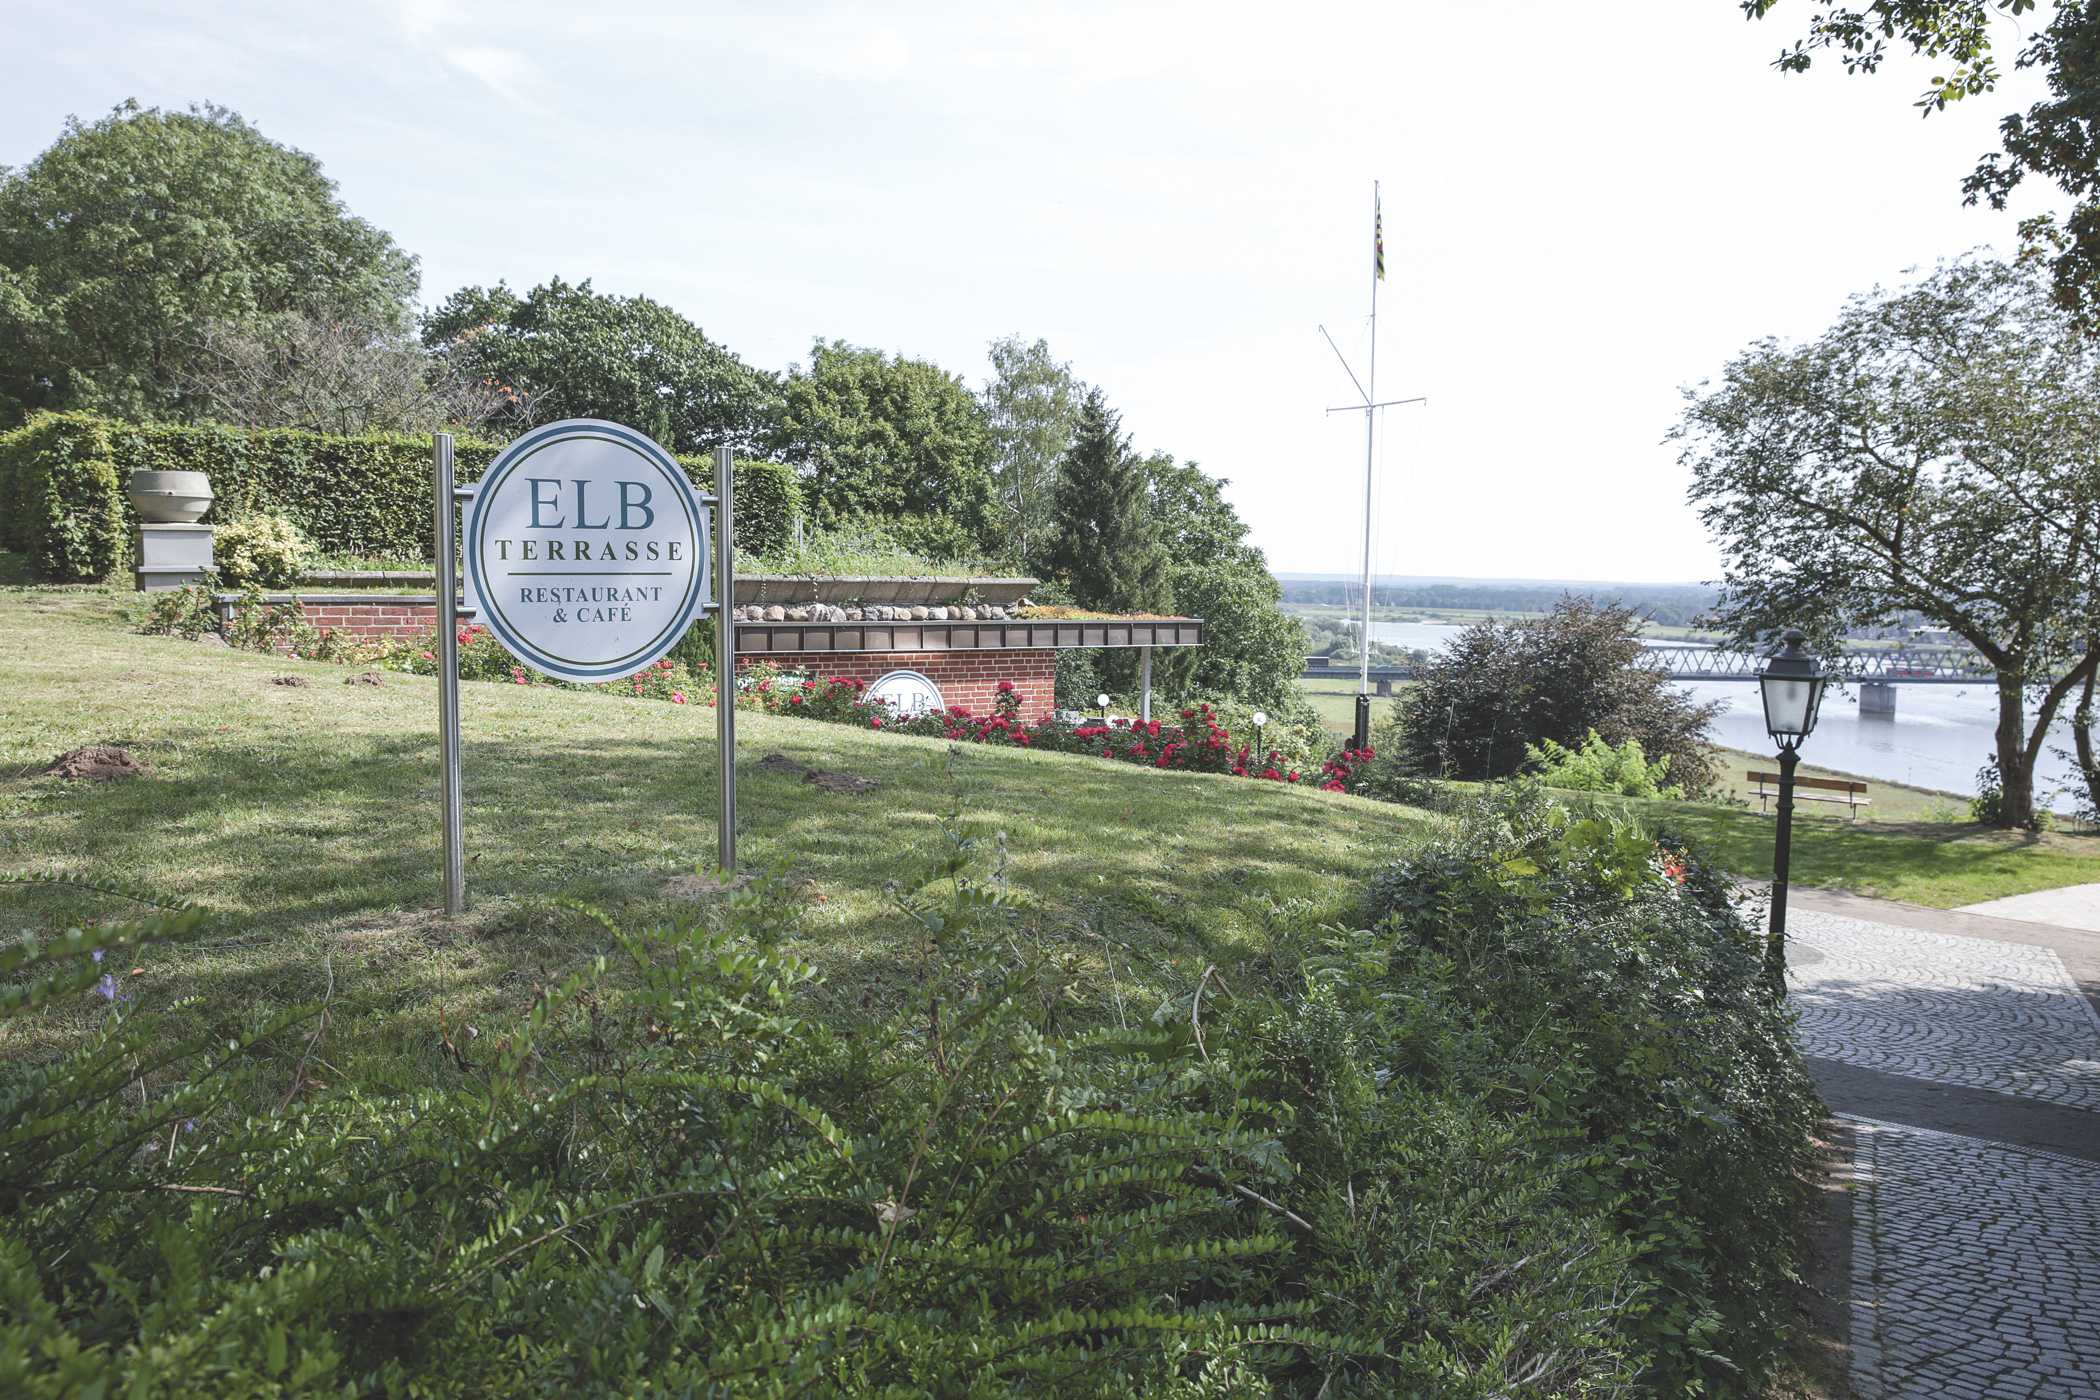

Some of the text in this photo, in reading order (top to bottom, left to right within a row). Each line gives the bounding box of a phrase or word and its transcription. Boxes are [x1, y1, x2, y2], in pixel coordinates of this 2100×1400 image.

[525, 478, 655, 530] ELB
[495, 540, 682, 561] TERRASSE
[520, 586, 662, 603] RESTAURANT
[553, 603, 632, 623] & CAFÉ
